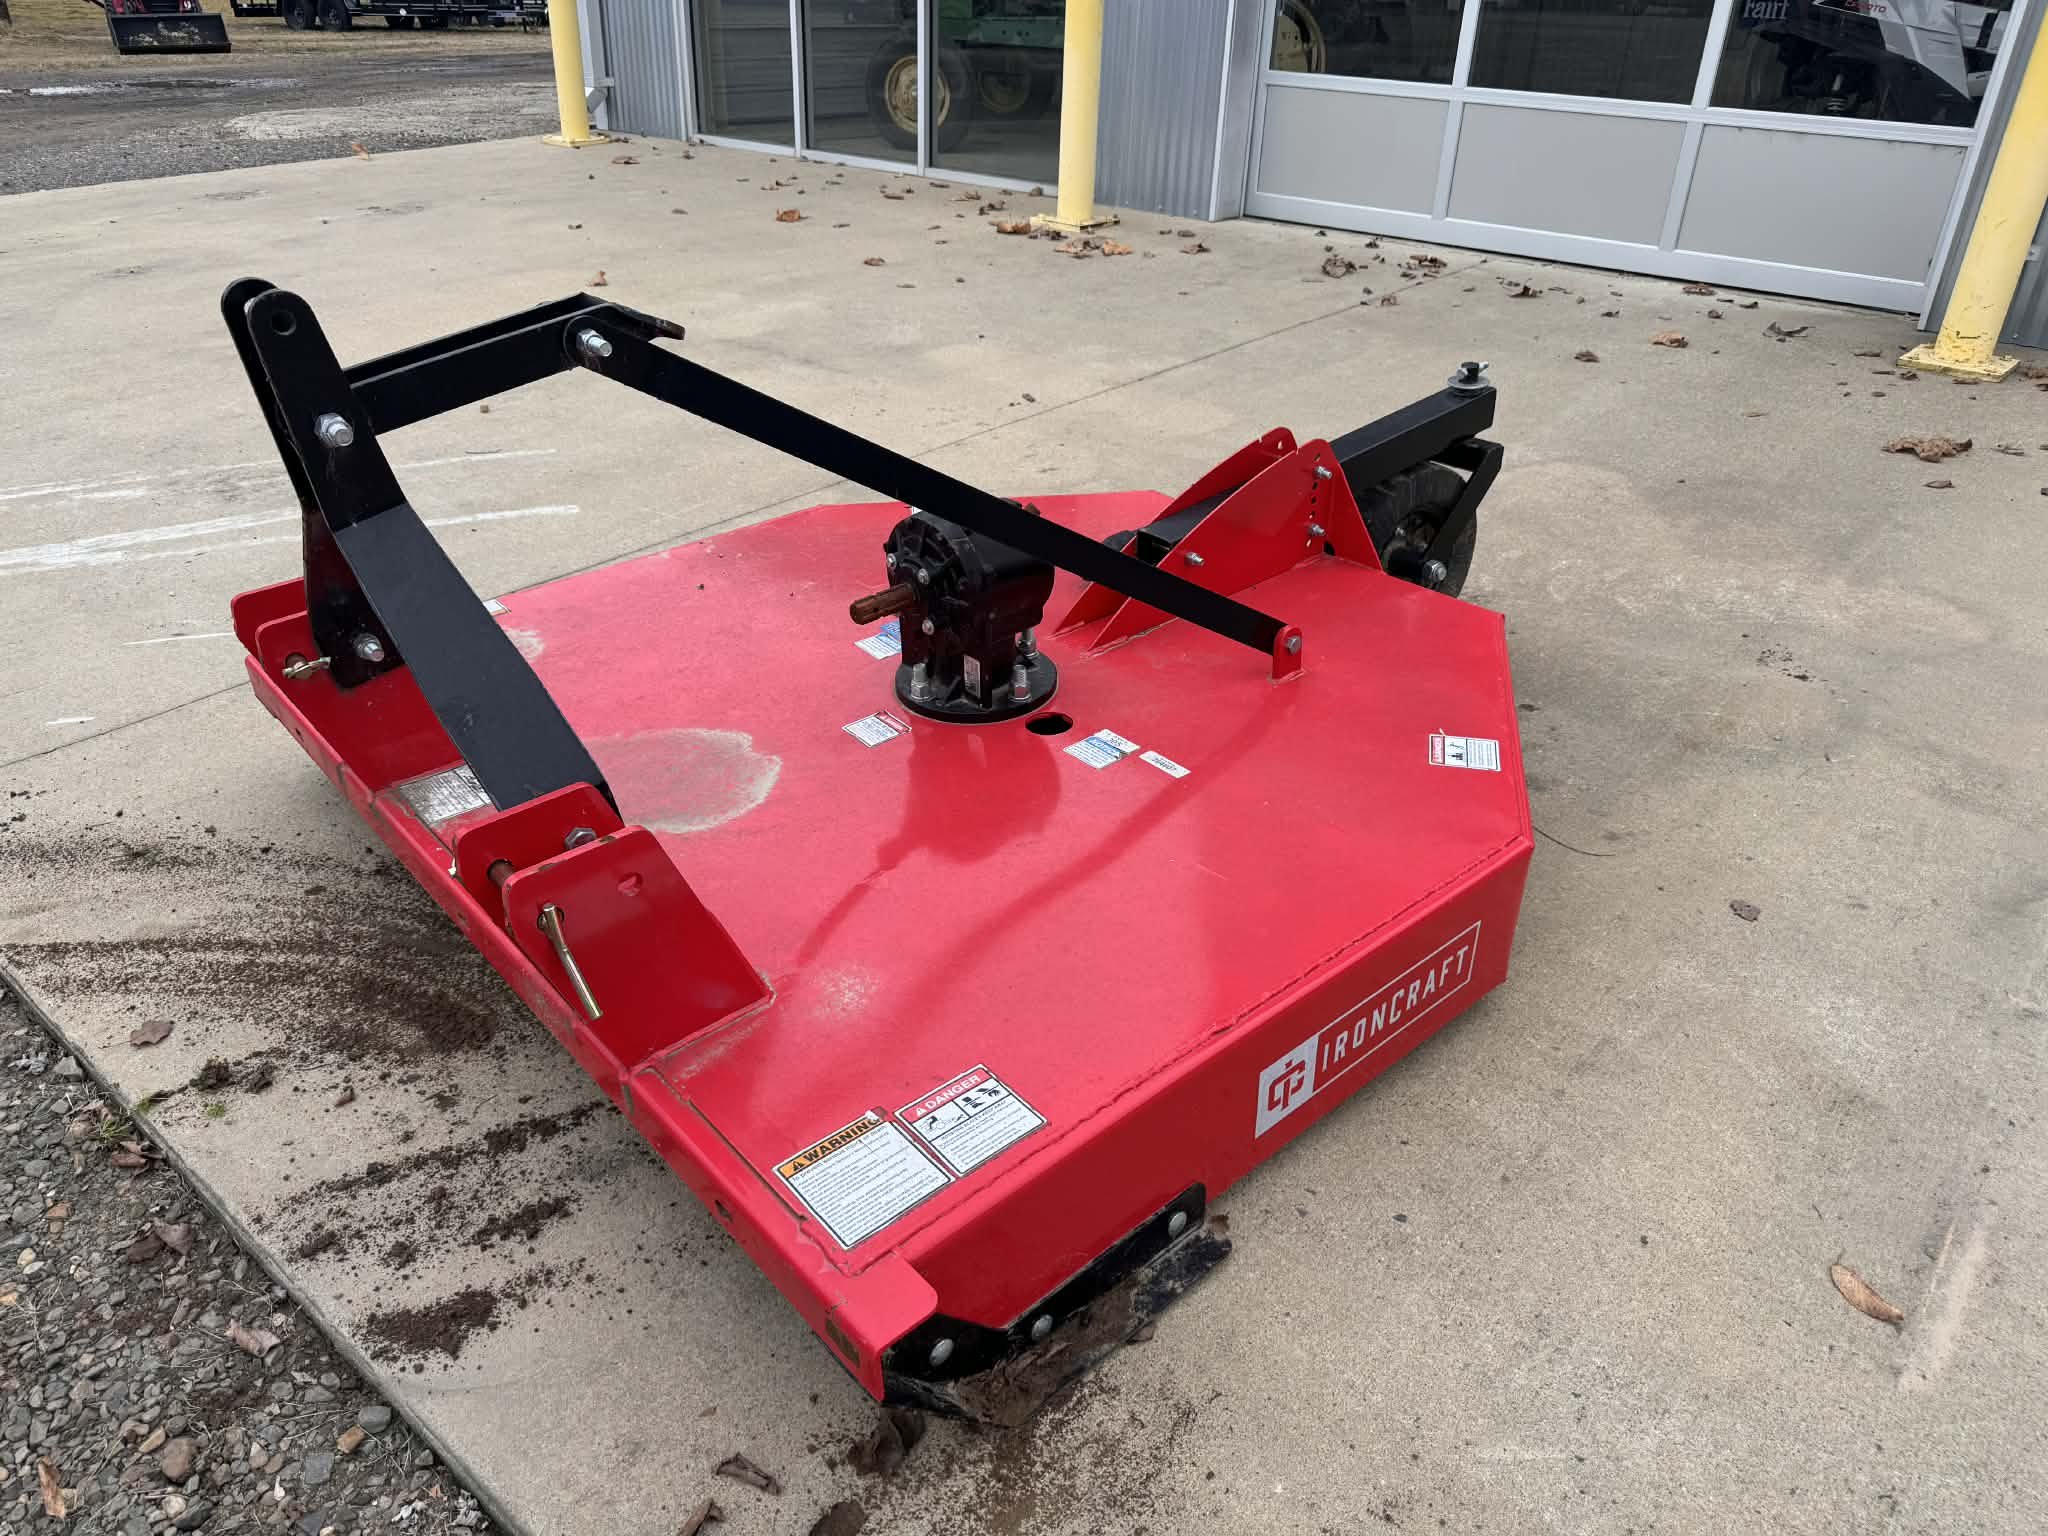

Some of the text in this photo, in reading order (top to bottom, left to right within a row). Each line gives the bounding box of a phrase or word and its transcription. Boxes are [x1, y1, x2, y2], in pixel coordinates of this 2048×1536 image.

[1321, 944, 1469, 1073] IRONCRAFT
[924, 1074, 982, 1110] DANGER
[802, 1118, 880, 1162] WARNING
